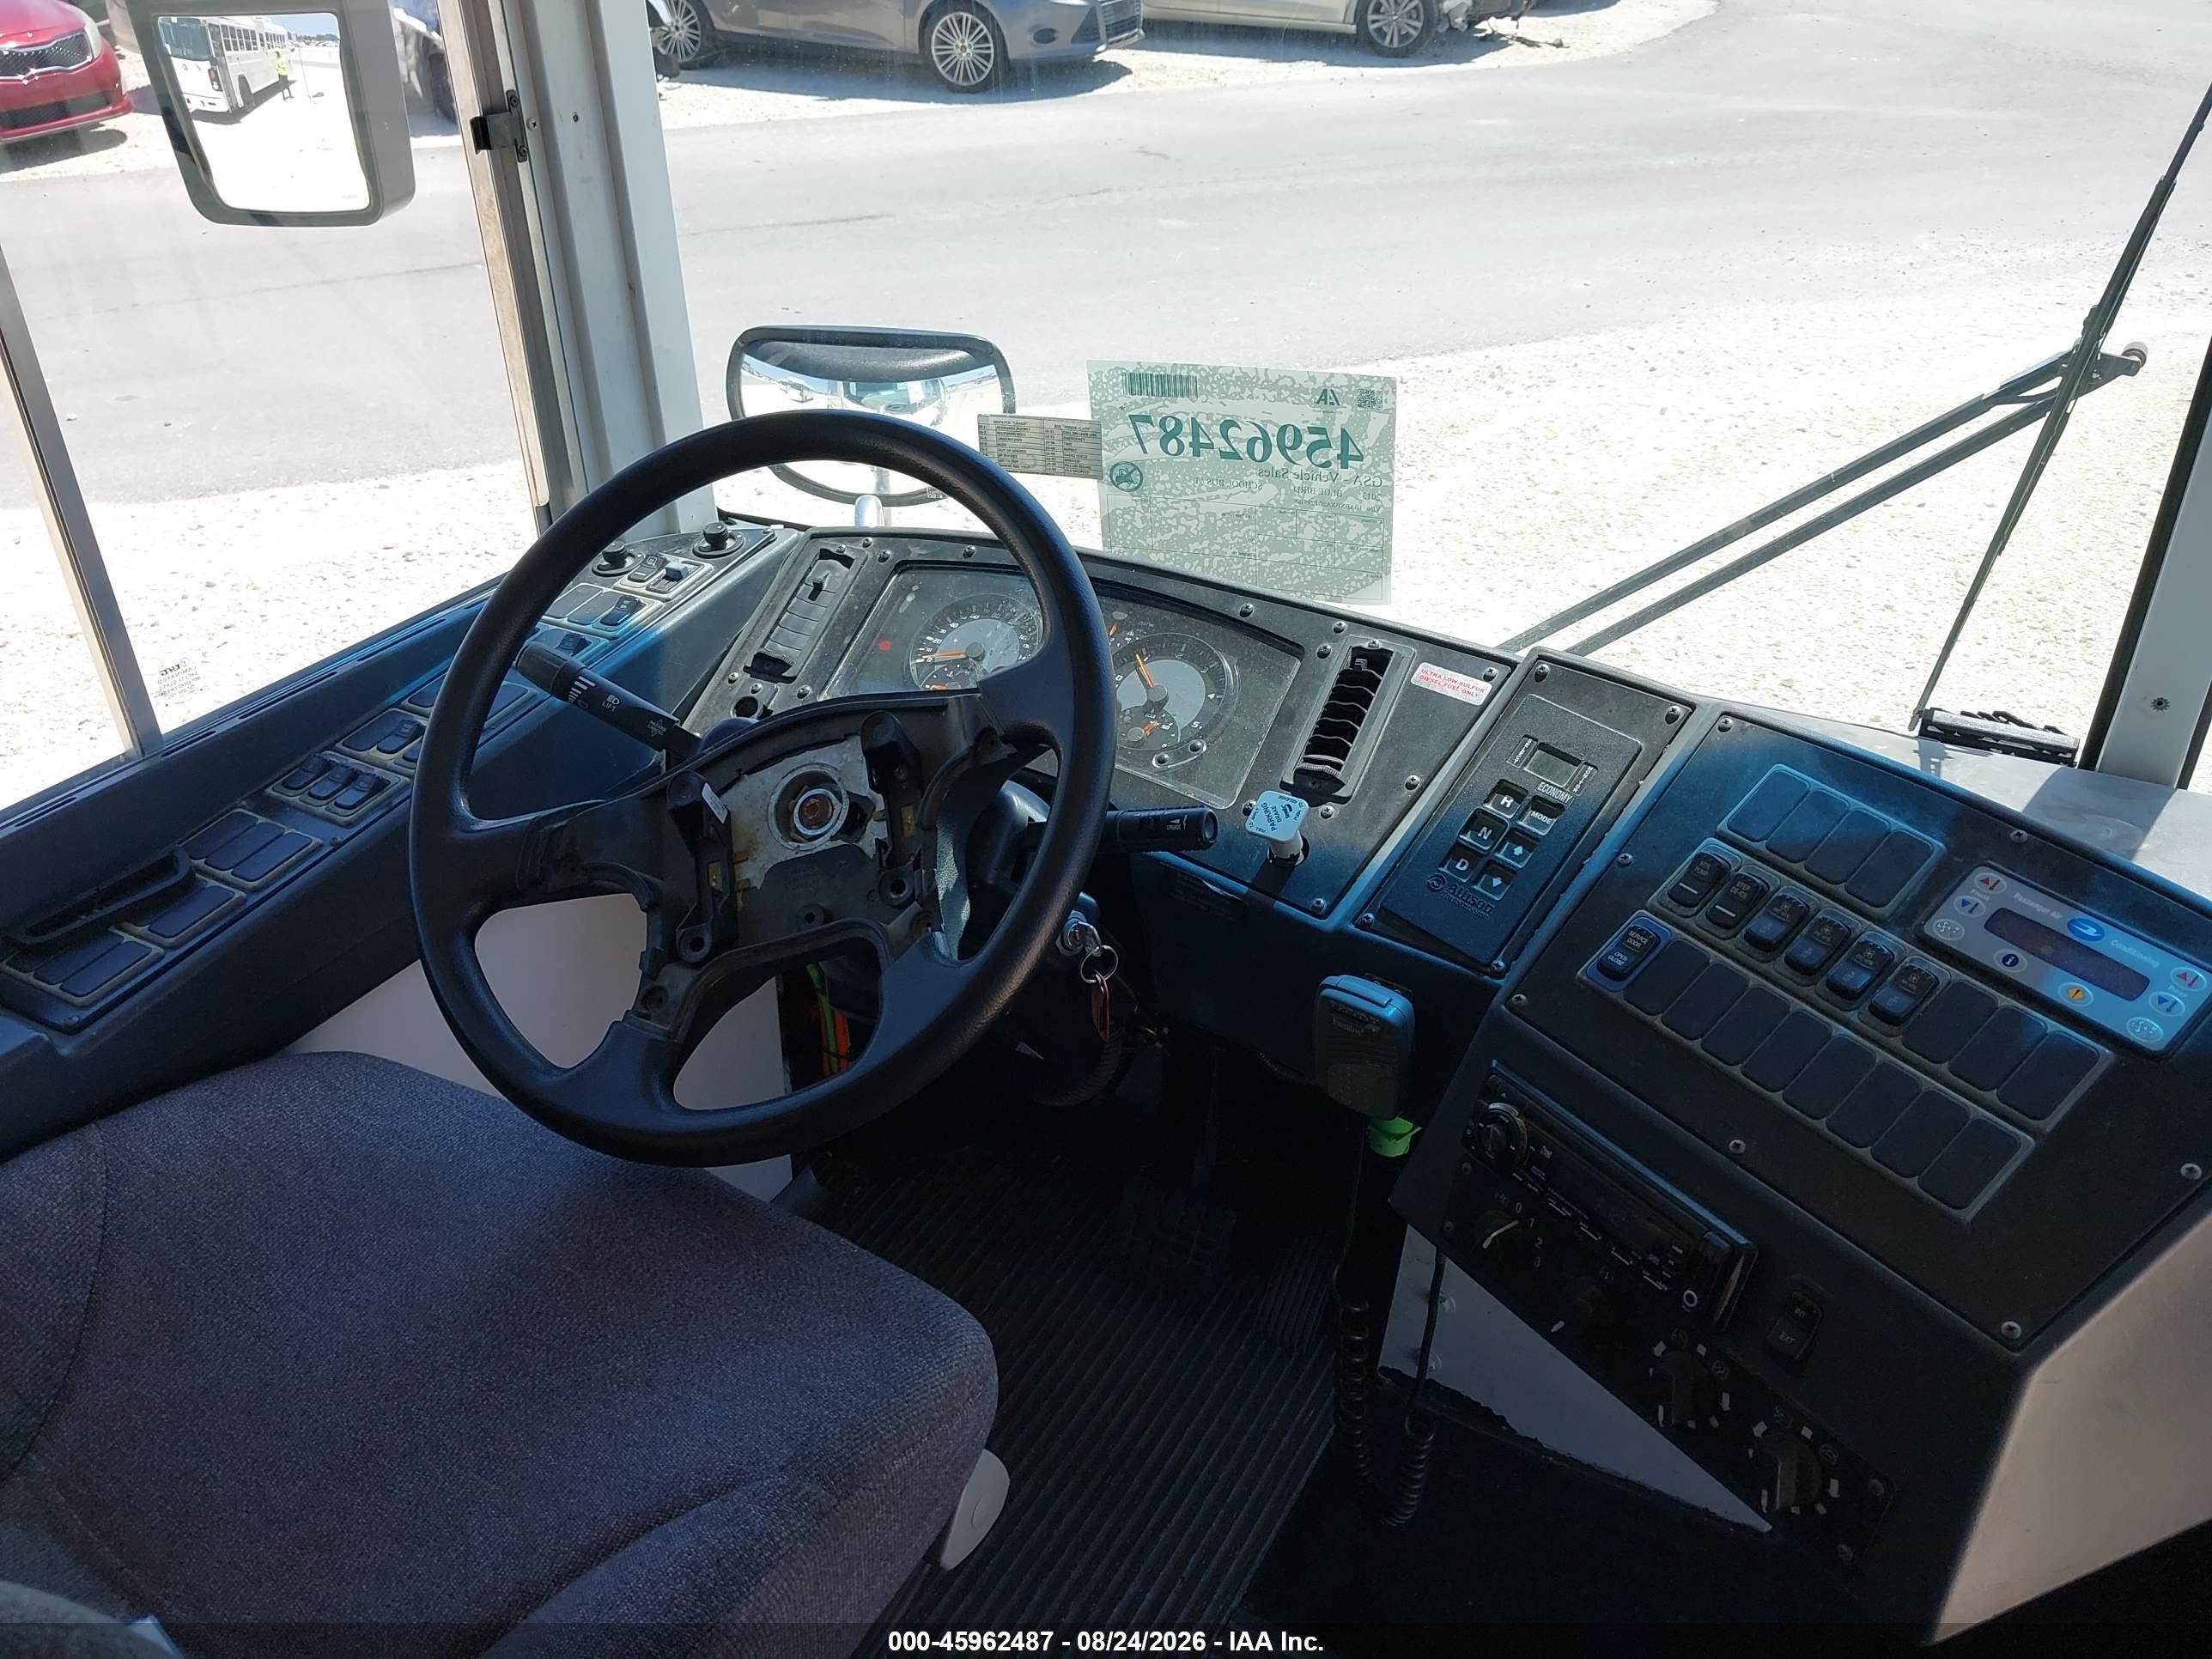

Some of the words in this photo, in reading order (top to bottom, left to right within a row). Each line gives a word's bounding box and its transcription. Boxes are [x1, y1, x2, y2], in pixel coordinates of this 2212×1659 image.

[1419, 675, 1442, 686] DIESEL
[1443, 683, 1460, 691] FUEL
[1462, 689, 1480, 697] ONLY
[1421, 668, 1442, 679] ULTRA
[1460, 681, 1486, 693] SULFUR
[602, 701, 617, 712] LIFT
[1572, 766, 1594, 793] MONITOR
[1537, 781, 1573, 804] ECONOMY
[1261, 802, 1278, 831] PARKING
[1271, 805, 1282, 823] BRAKE
[1531, 811, 1552, 825] MODE
[1478, 826, 1493, 841] N
[1455, 858, 1469, 871] D
[1448, 883, 1495, 914] Allison
[2013, 892, 2051, 915] Passenger
[1626, 937, 1642, 949] DOOR
[1628, 930, 1650, 945] SERVICE
[1613, 951, 1628, 961] OPEN
[2110, 939, 2160, 969] Conditioning
